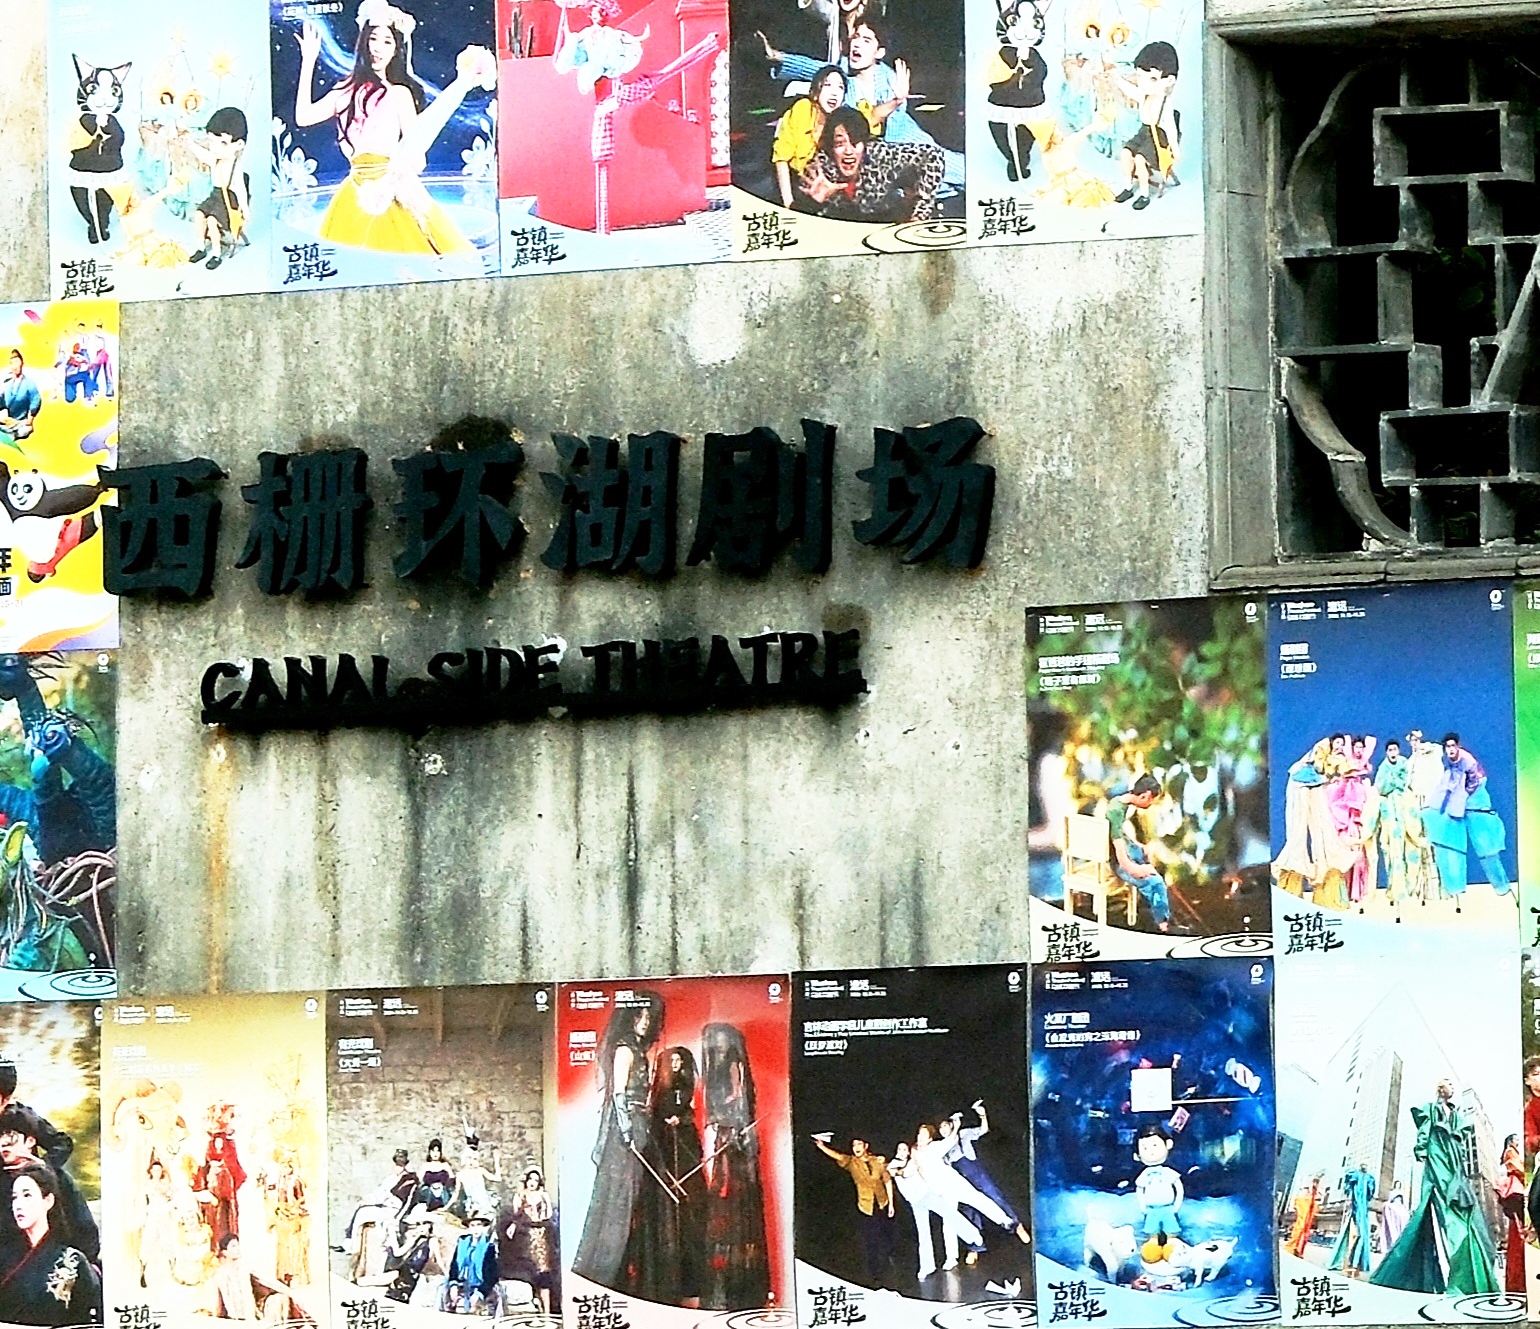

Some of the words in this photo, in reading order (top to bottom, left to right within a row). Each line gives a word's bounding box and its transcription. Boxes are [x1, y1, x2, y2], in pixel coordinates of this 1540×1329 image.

[977, 197, 1015, 217] 古镇
[511, 226, 547, 247] 古镇
[979, 215, 1035, 239] 嘉年华
[282, 242, 318, 263] 古镇
[513, 244, 566, 268] 嘉年华
[60, 258, 96, 279] 古镇
[284, 260, 337, 284] 嘉年华
[62, 275, 115, 300] 嘉年华
[201, 653, 390, 716] CANAL
[428, 642, 562, 706] SIDE
[580, 627, 867, 701] THEATRE
[1283, 911, 1323, 933] 古镇
[1285, 930, 1345, 955] 嘉年华
[808, 1286, 846, 1306] 古镇
[1048, 1281, 1086, 1301] 古镇
[113, 1304, 149, 1324] 古镇
[572, 1294, 610, 1314] 古镇
[1050, 1299, 1106, 1324] 嘉年华
[810, 1304, 866, 1328] 嘉年华
